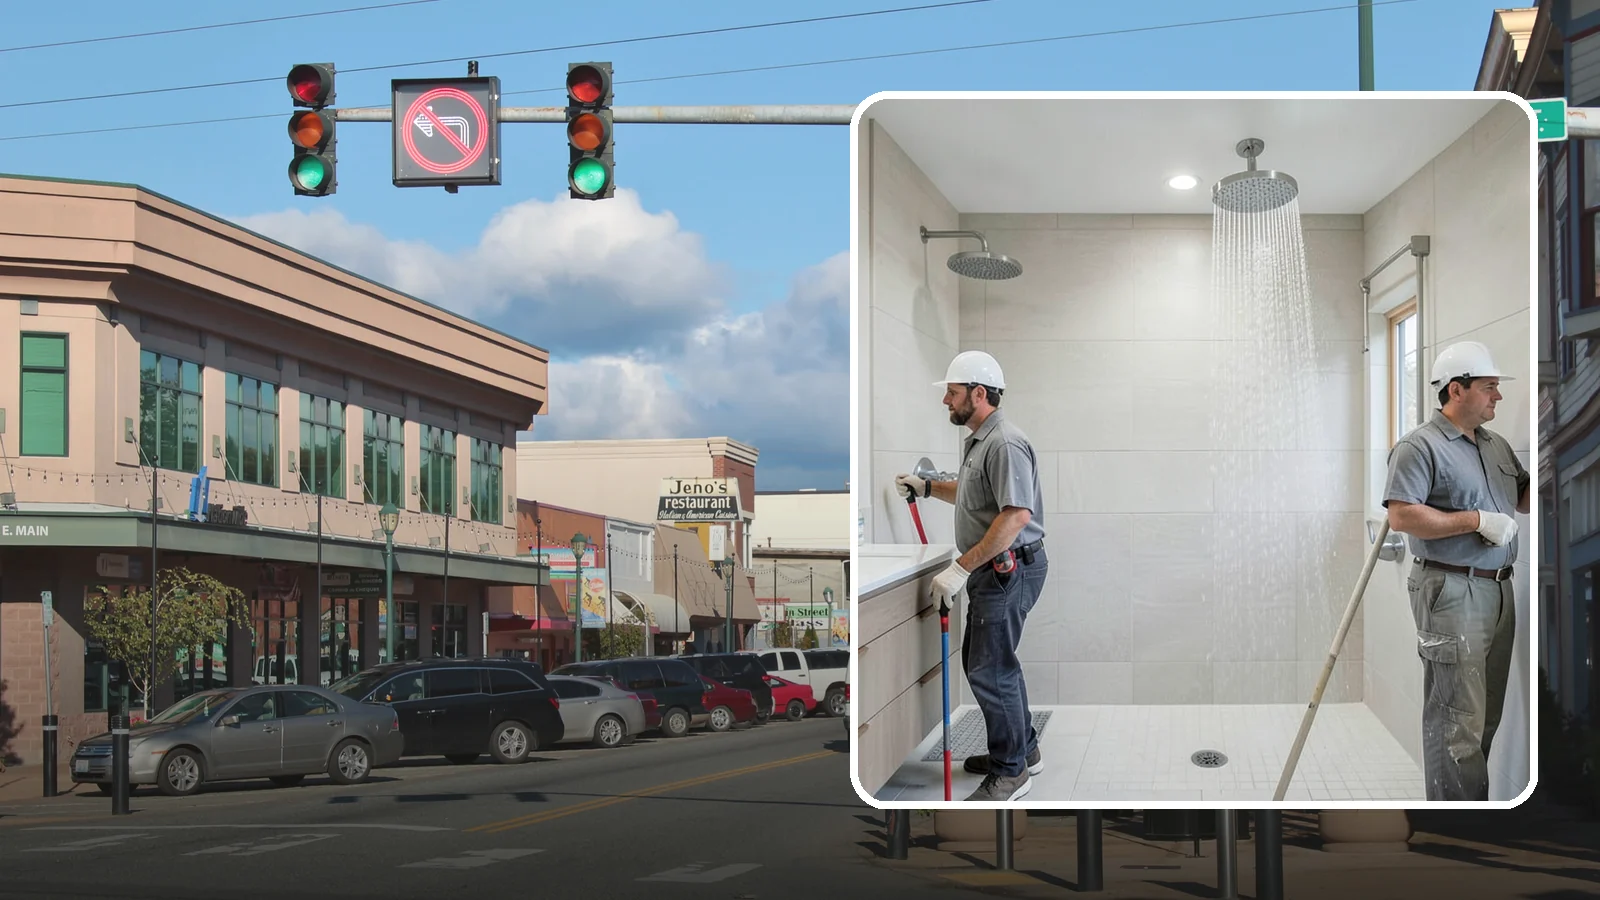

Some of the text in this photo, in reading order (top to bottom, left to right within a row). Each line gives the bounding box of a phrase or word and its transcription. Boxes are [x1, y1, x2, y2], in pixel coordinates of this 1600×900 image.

[669, 480, 728, 495] Jeno's
[665, 496, 731, 509] restaurant
[659, 510, 682, 519] Italian
[686, 509, 715, 519] American
[715, 509, 737, 520] Cuisine
[2, 525, 49, 536] E. MAIN
[797, 607, 828, 617] Street
